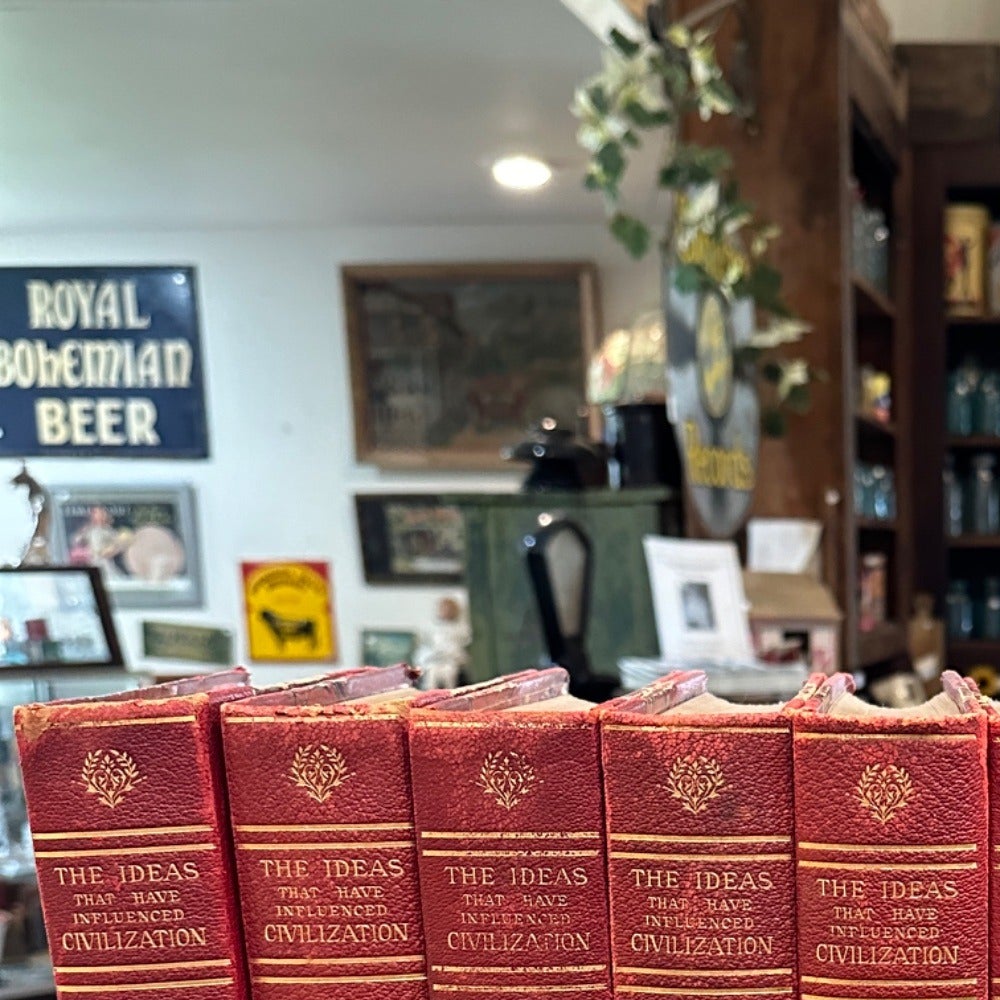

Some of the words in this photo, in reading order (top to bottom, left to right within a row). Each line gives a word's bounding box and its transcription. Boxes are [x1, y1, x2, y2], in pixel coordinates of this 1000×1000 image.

[26, 278, 151, 330] ROYAL
[35, 396, 161, 446] BEER
[54, 866, 103, 886] THE
[118, 862, 200, 884] IDEAS
[259, 859, 309, 878] THE
[324, 859, 405, 878] IDEAS
[444, 866, 495, 886] THE
[510, 867, 588, 886] IDEAS
[631, 869, 680, 888] THE
[695, 871, 773, 890] IDEAS
[816, 879, 864, 898] THE
[880, 880, 959, 899] IDEAS
[74, 893, 115, 906] THAT
[133, 891, 181, 903] HAVE
[277, 886, 318, 899] THAT
[338, 885, 384, 898] HAVE
[463, 894, 505, 906] THAT
[523, 894, 568, 907] HAVE
[277, 904, 387, 917] INFLUENCED
[648, 897, 689, 910] THAT
[708, 899, 752, 912] HAVE
[833, 907, 875, 921] THAT
[892, 908, 938, 921] HAVE
[73, 909, 185, 924] INFLUENCED
[461, 913, 571, 925] INFLUENCED
[646, 915, 753, 930] INFLUENCED
[62, 927, 206, 951] CIVILIZATION
[264, 922, 409, 944] CIVILIZATION
[447, 932, 591, 951] CIVILIZATION
[830, 925, 940, 940] INFLUENCED
[631, 933, 774, 956] CIVILIZATION
[816, 944, 959, 966] CIVILIZATION
